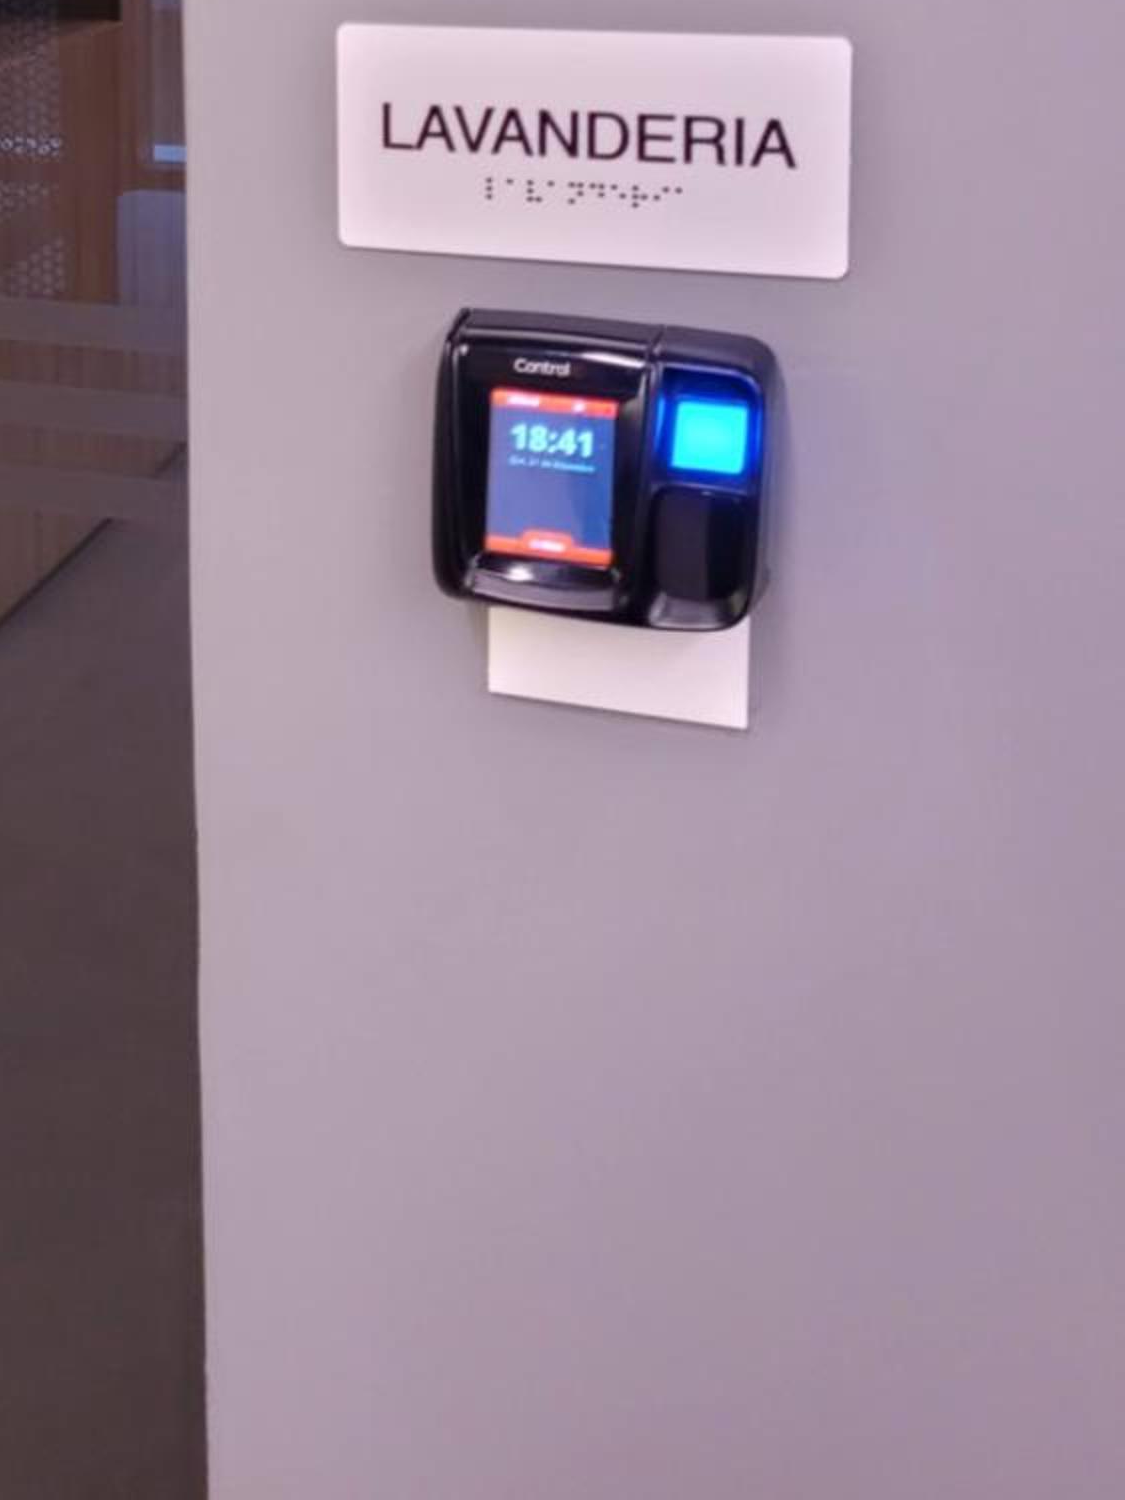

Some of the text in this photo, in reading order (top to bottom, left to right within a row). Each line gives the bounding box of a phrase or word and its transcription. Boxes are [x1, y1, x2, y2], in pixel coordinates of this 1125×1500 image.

[381, 102, 797, 169] LAVANDERIA
[513, 357, 572, 377] Control
[510, 423, 594, 458] 18:41
